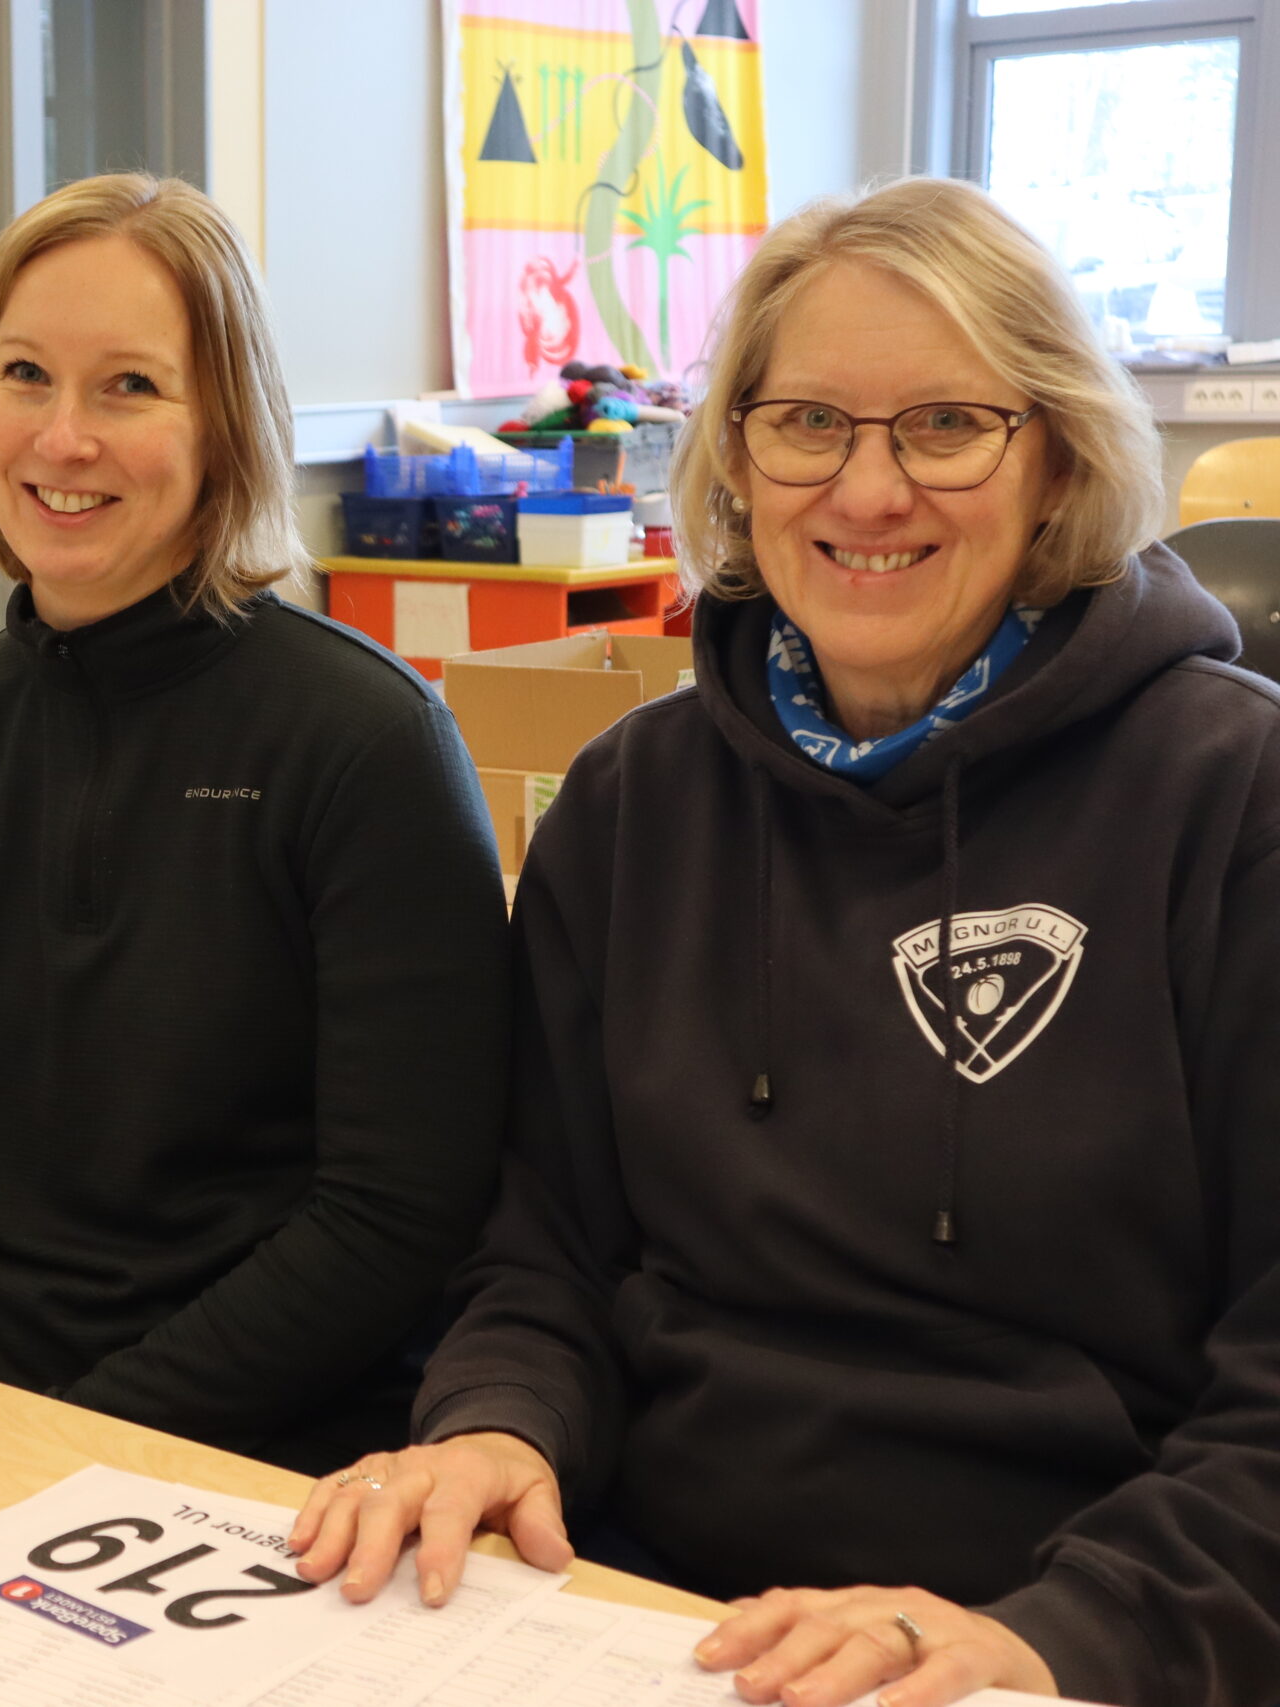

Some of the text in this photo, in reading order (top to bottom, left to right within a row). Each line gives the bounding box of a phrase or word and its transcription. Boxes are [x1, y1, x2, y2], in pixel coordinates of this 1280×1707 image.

[912, 917, 1067, 956] MGNOR U.L.
[951, 952, 1022, 979] 24.5.1898
[172, 1504, 210, 1526] UL
[27, 1517, 318, 1631] 219
[30, 1596, 128, 1645] SpareBank
[45, 1591, 118, 1626] ØSTLANDET
